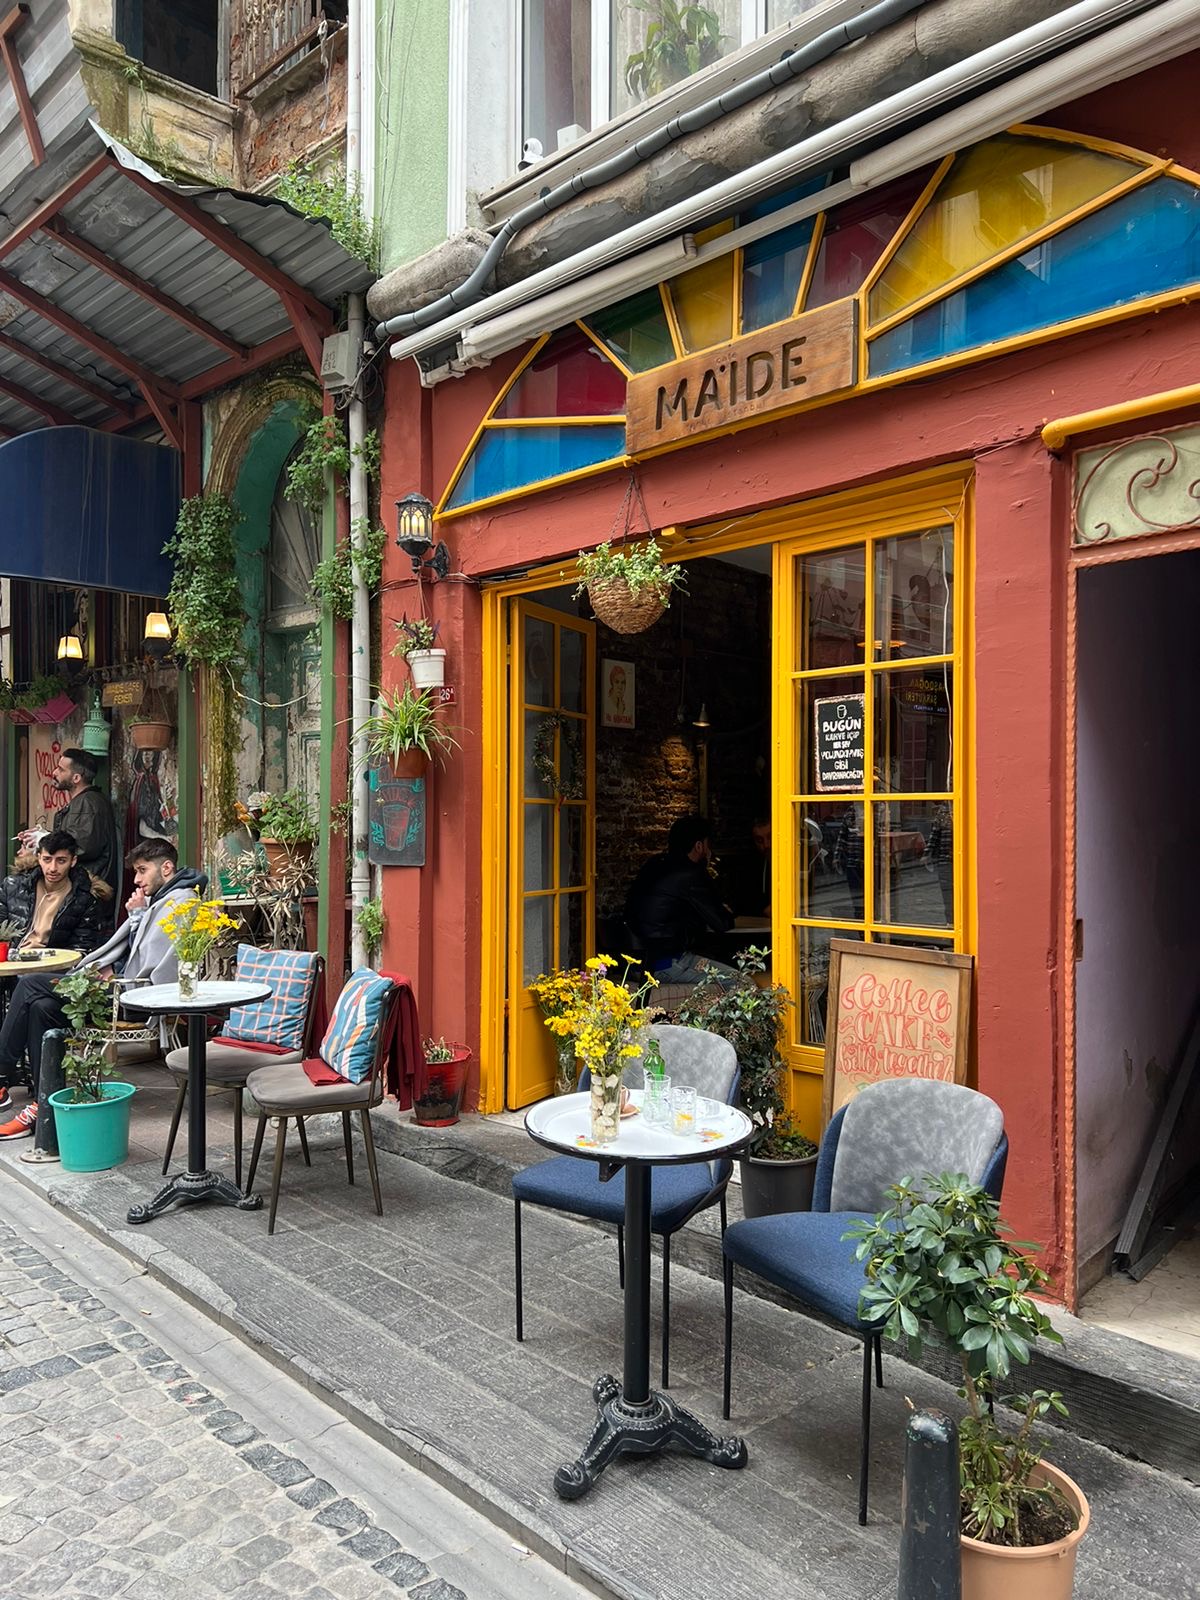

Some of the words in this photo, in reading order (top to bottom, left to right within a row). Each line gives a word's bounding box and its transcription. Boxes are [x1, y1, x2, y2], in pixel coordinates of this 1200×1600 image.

[822, 717, 862, 733] BUGÜN
[841, 973, 952, 1023] Coffee
[854, 1010, 933, 1053] CAKE
